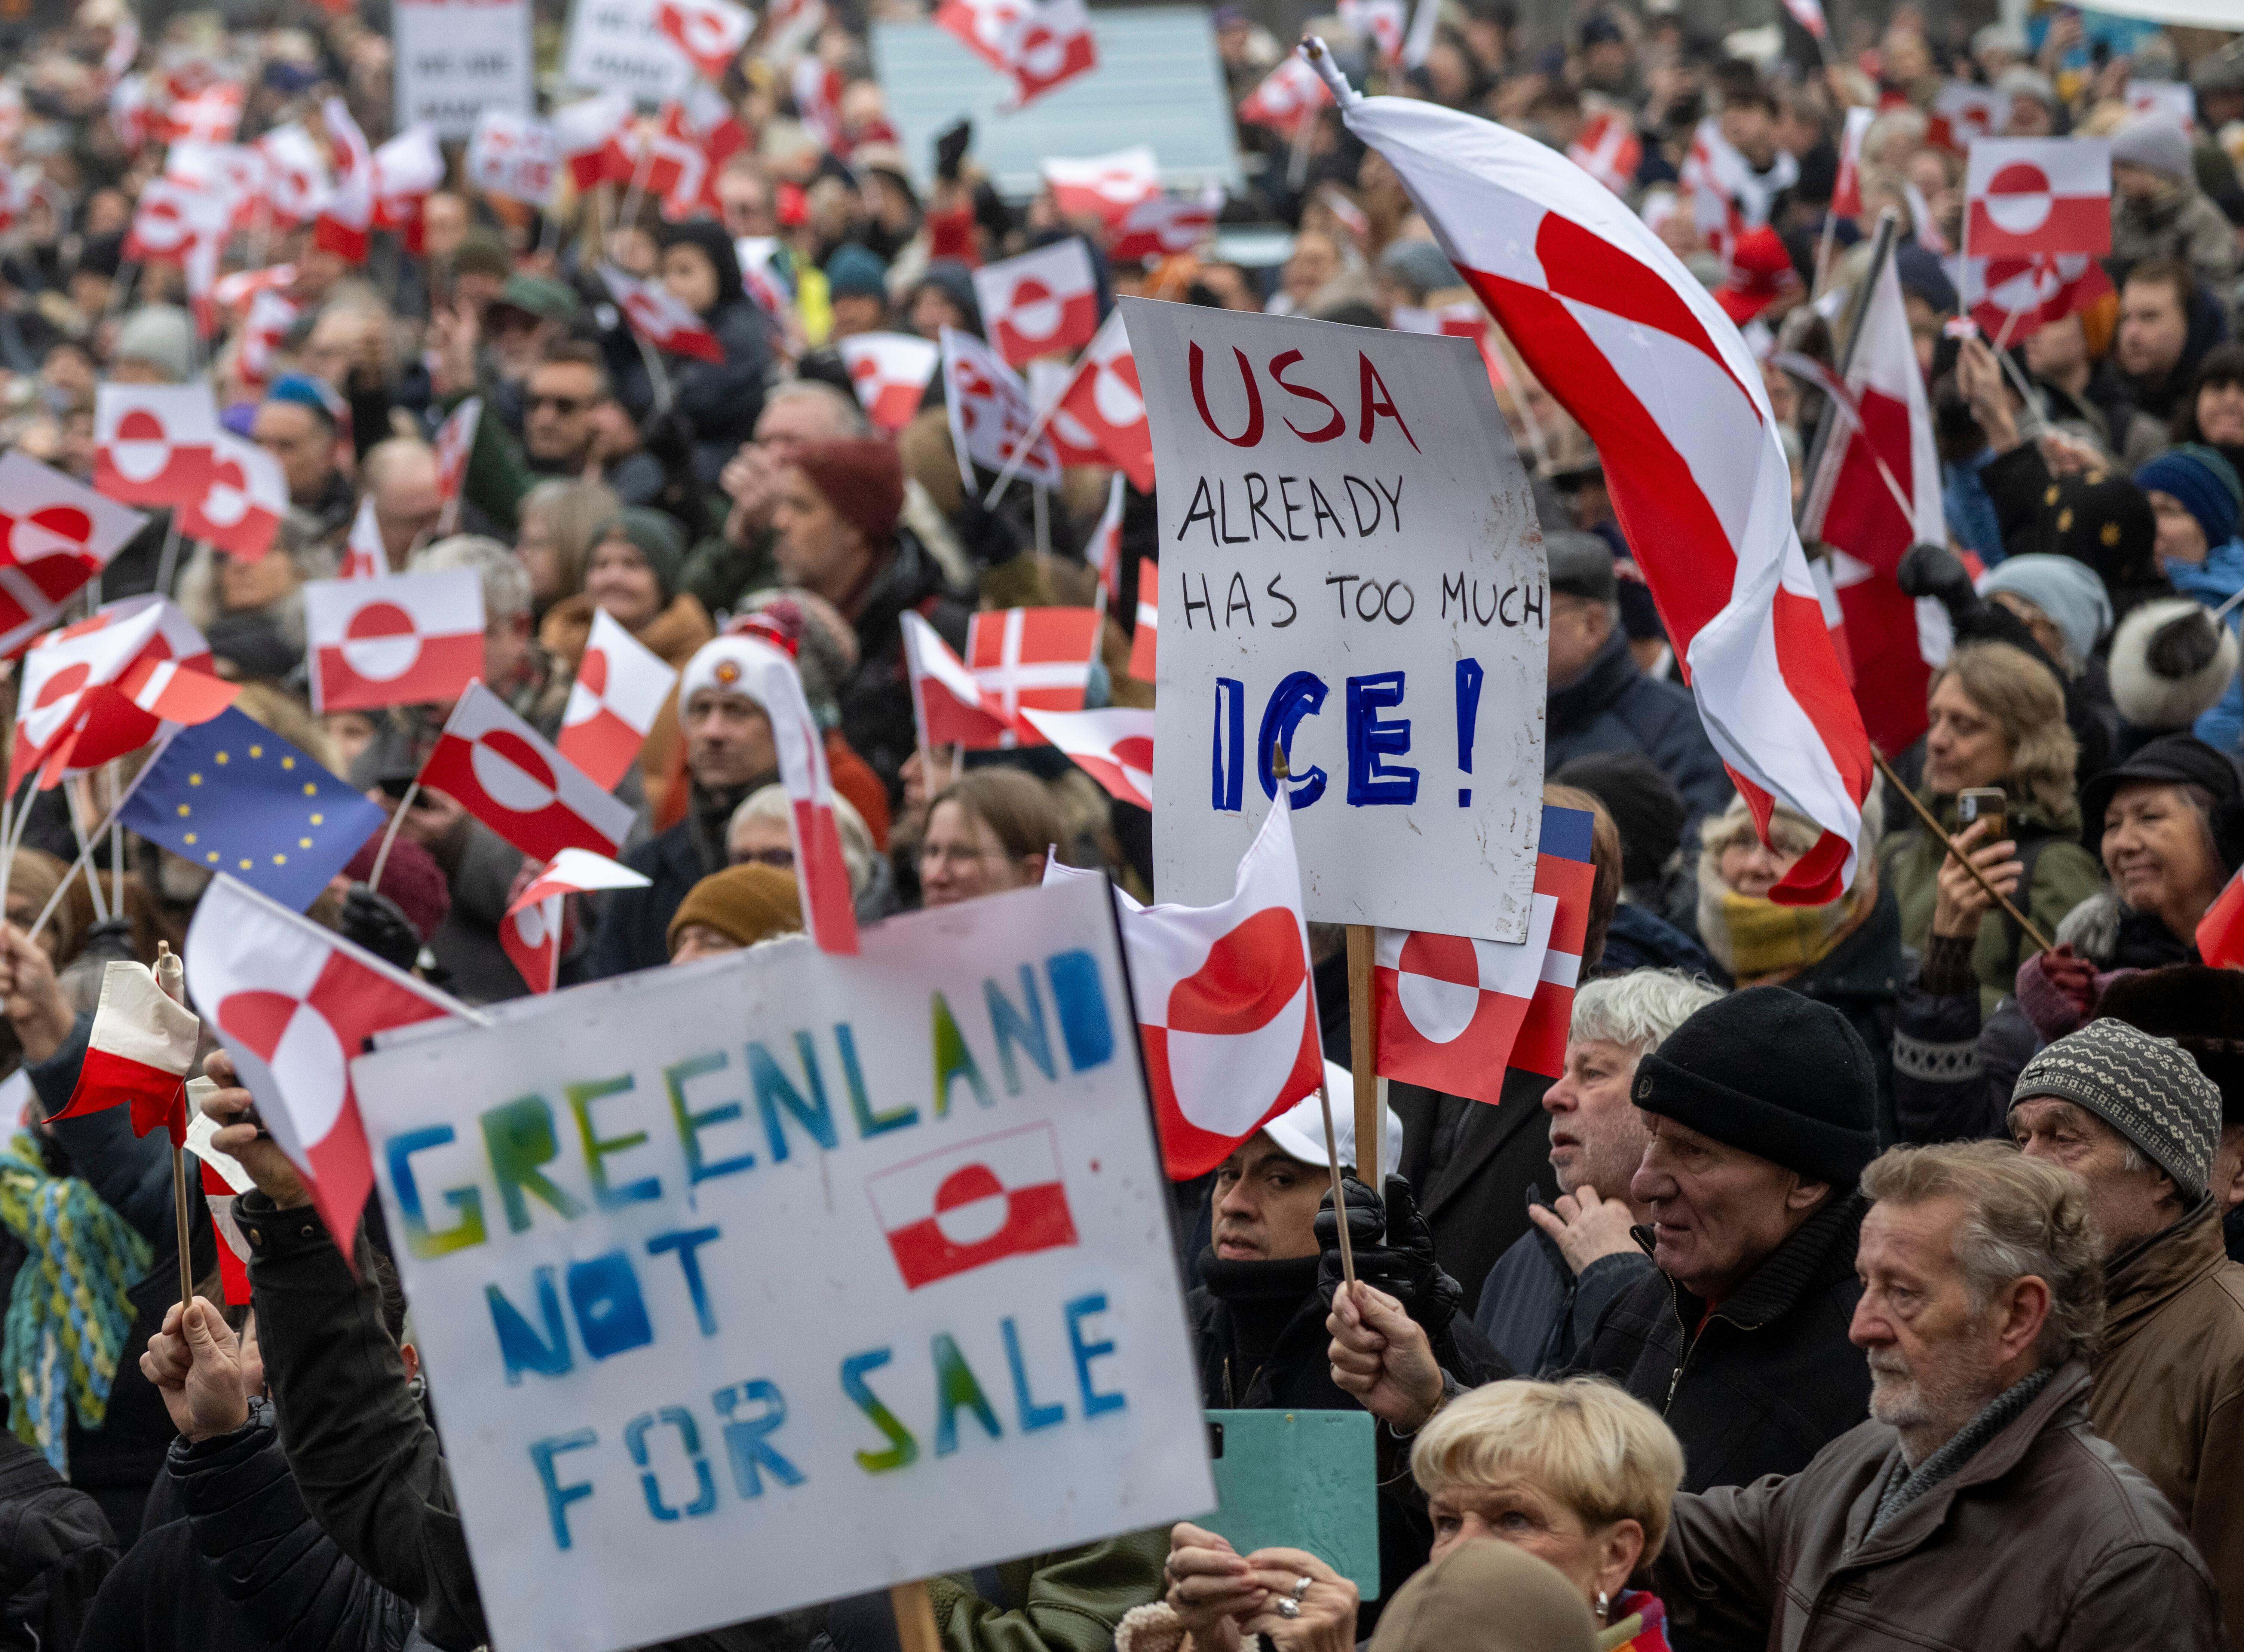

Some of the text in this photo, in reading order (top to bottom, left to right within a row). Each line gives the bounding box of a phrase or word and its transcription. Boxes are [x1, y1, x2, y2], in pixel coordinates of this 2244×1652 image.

[1189, 340, 1421, 454] USA
[1177, 472, 1404, 547] ALREADY
[1182, 571, 1545, 632] HAS TOO MUCH
[384, 947, 1118, 1257] GREENLAND
[484, 1224, 722, 1386] NOT
[528, 1291, 1128, 1553] FOR SALE
